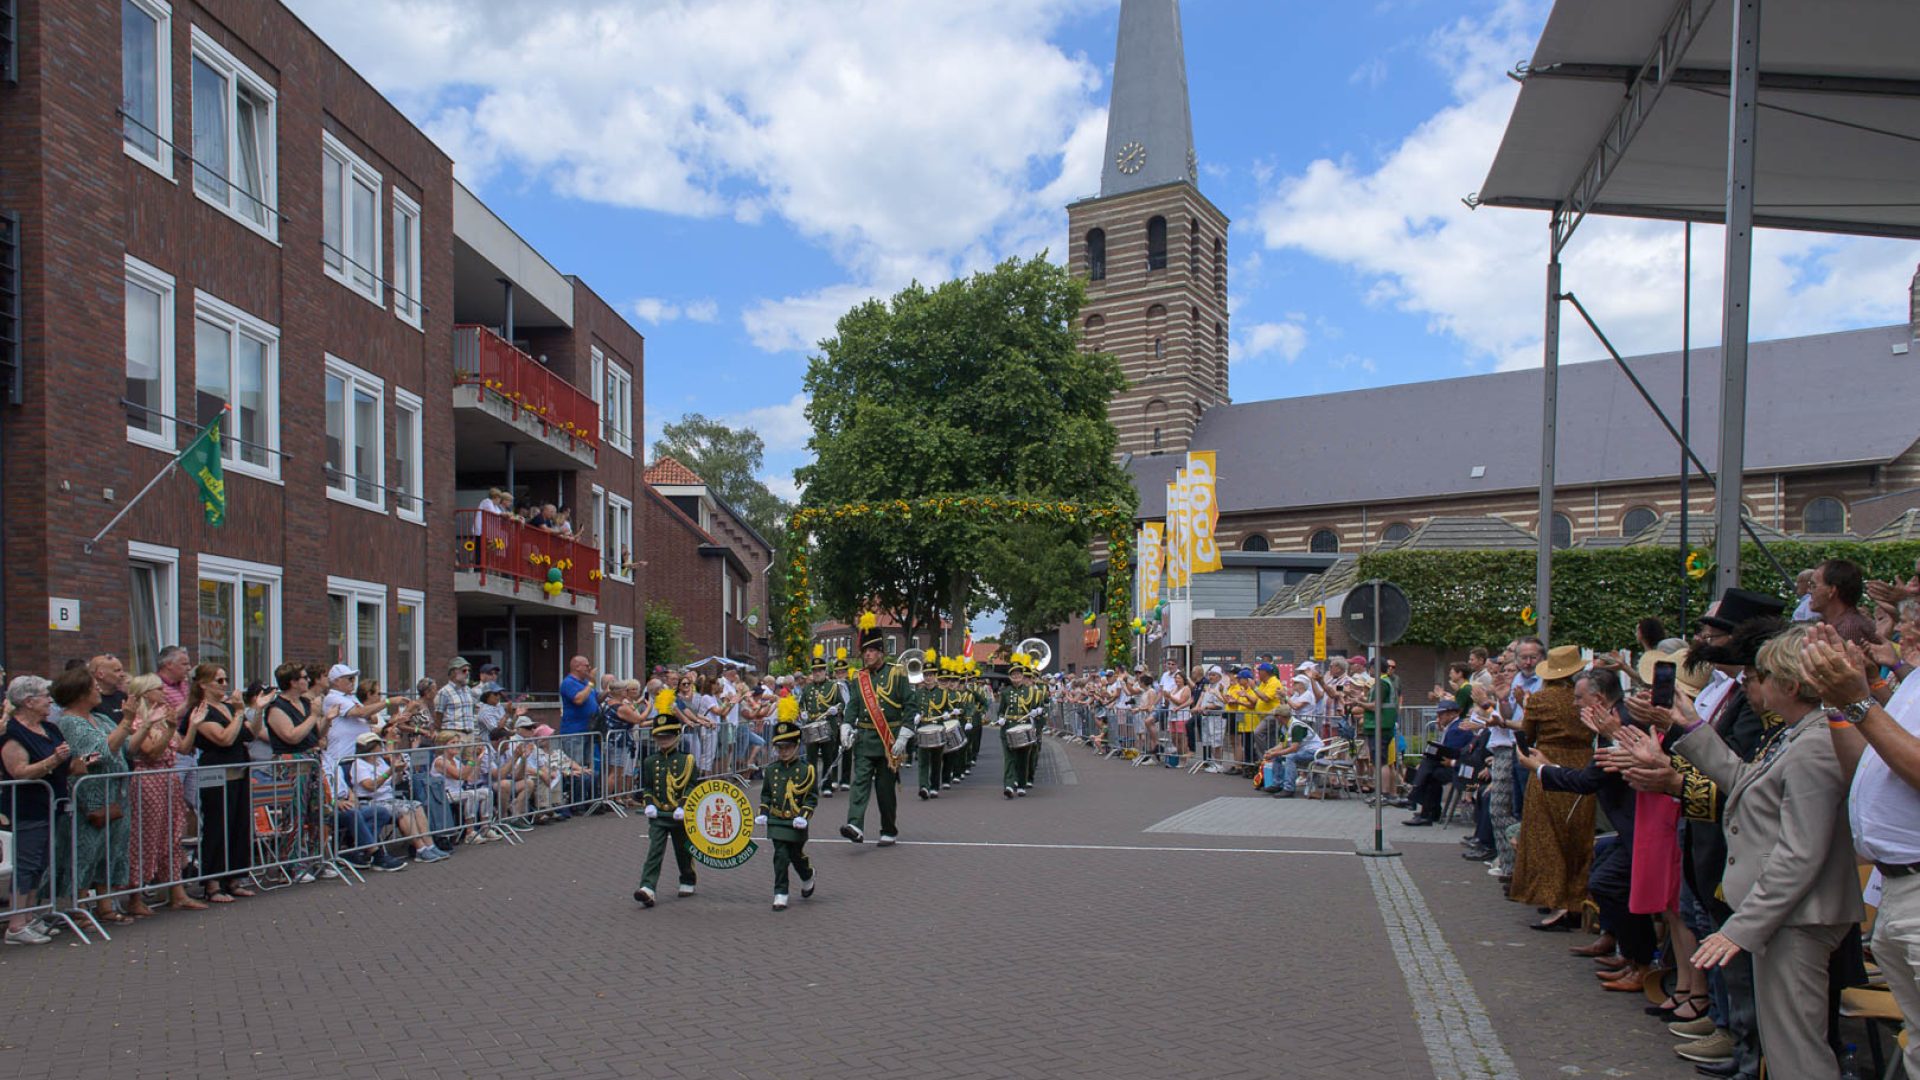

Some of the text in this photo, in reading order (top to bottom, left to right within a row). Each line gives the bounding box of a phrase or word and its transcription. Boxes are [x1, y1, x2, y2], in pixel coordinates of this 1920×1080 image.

[1188, 460, 1215, 562] coop
[60, 607, 69, 621] B
[689, 845, 703, 860] OLS
[703, 854, 738, 868] WINNAAR
